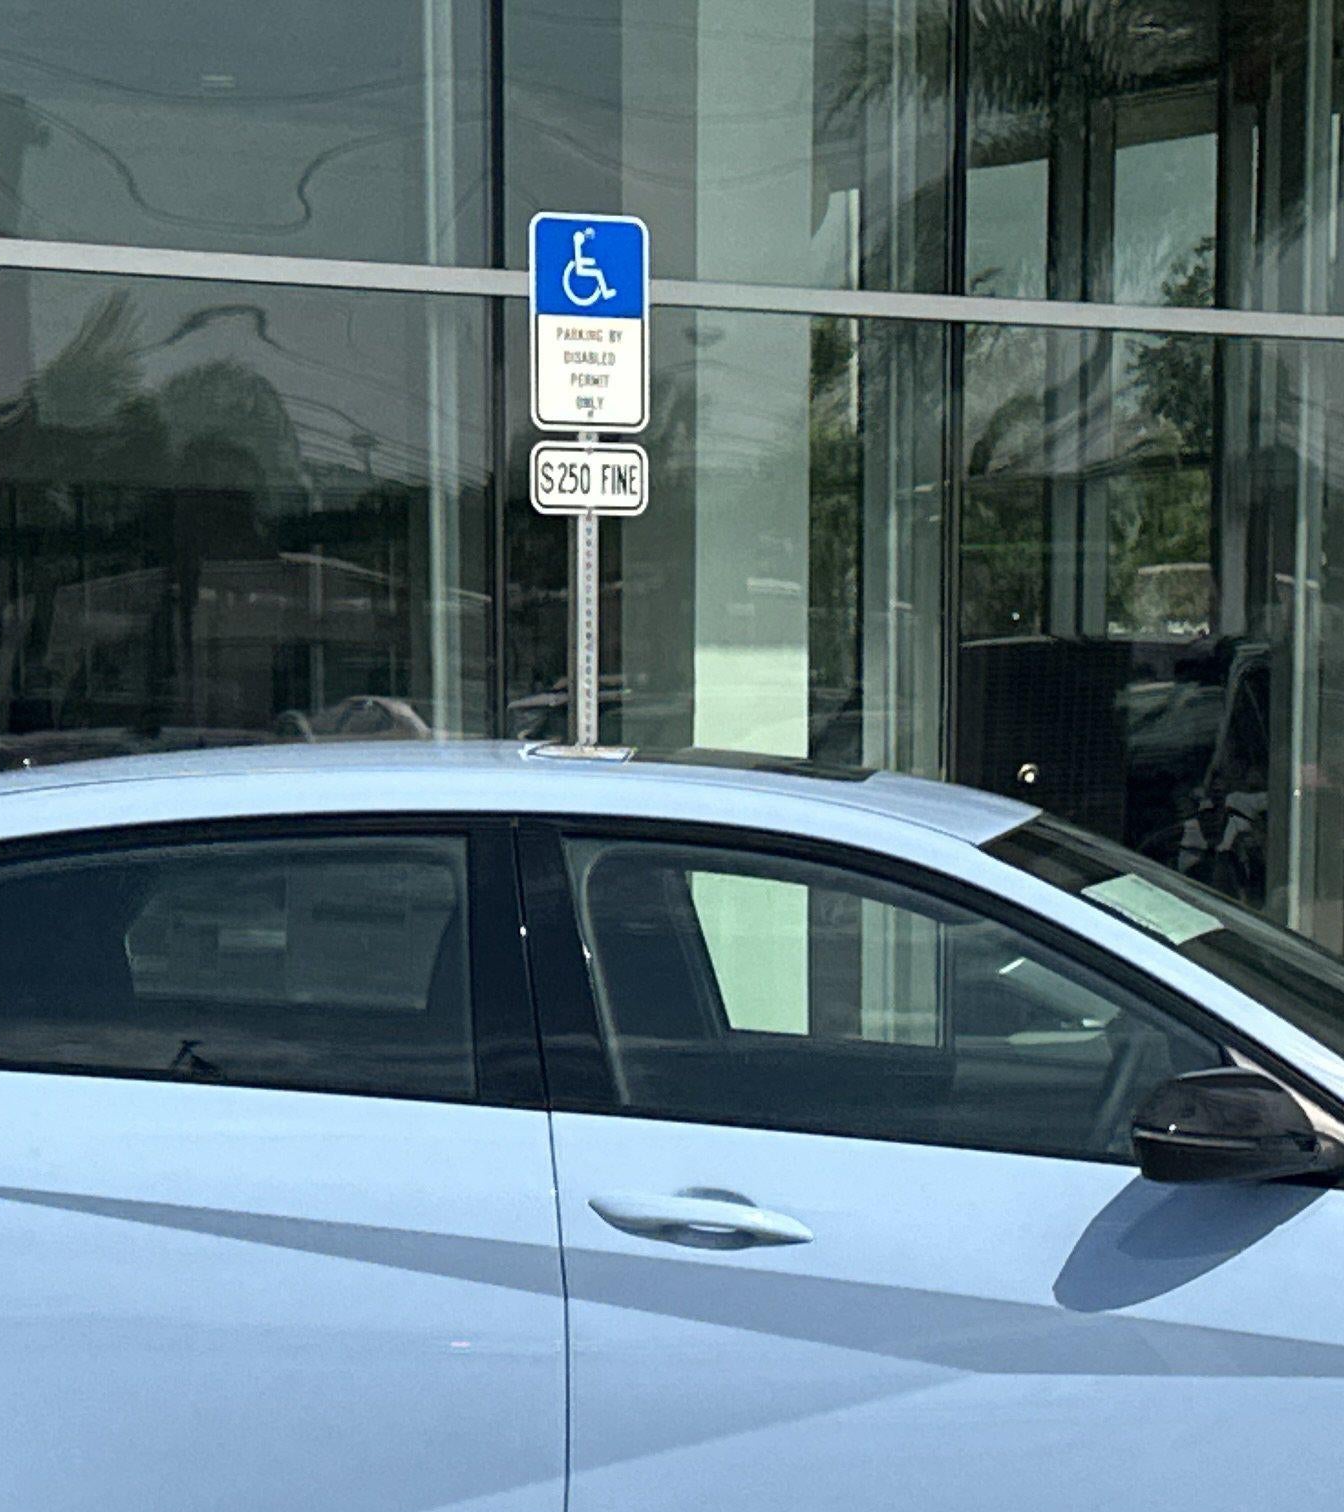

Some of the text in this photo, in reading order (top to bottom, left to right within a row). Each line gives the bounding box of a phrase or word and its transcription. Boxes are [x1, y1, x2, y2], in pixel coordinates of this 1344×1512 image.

[556, 326, 623, 344] PARKING BY
[563, 350, 616, 366] DISABLED
[570, 372, 610, 388] PERMIT
[575, 395, 605, 410] ONLY
[600, 463, 638, 496] FINE
